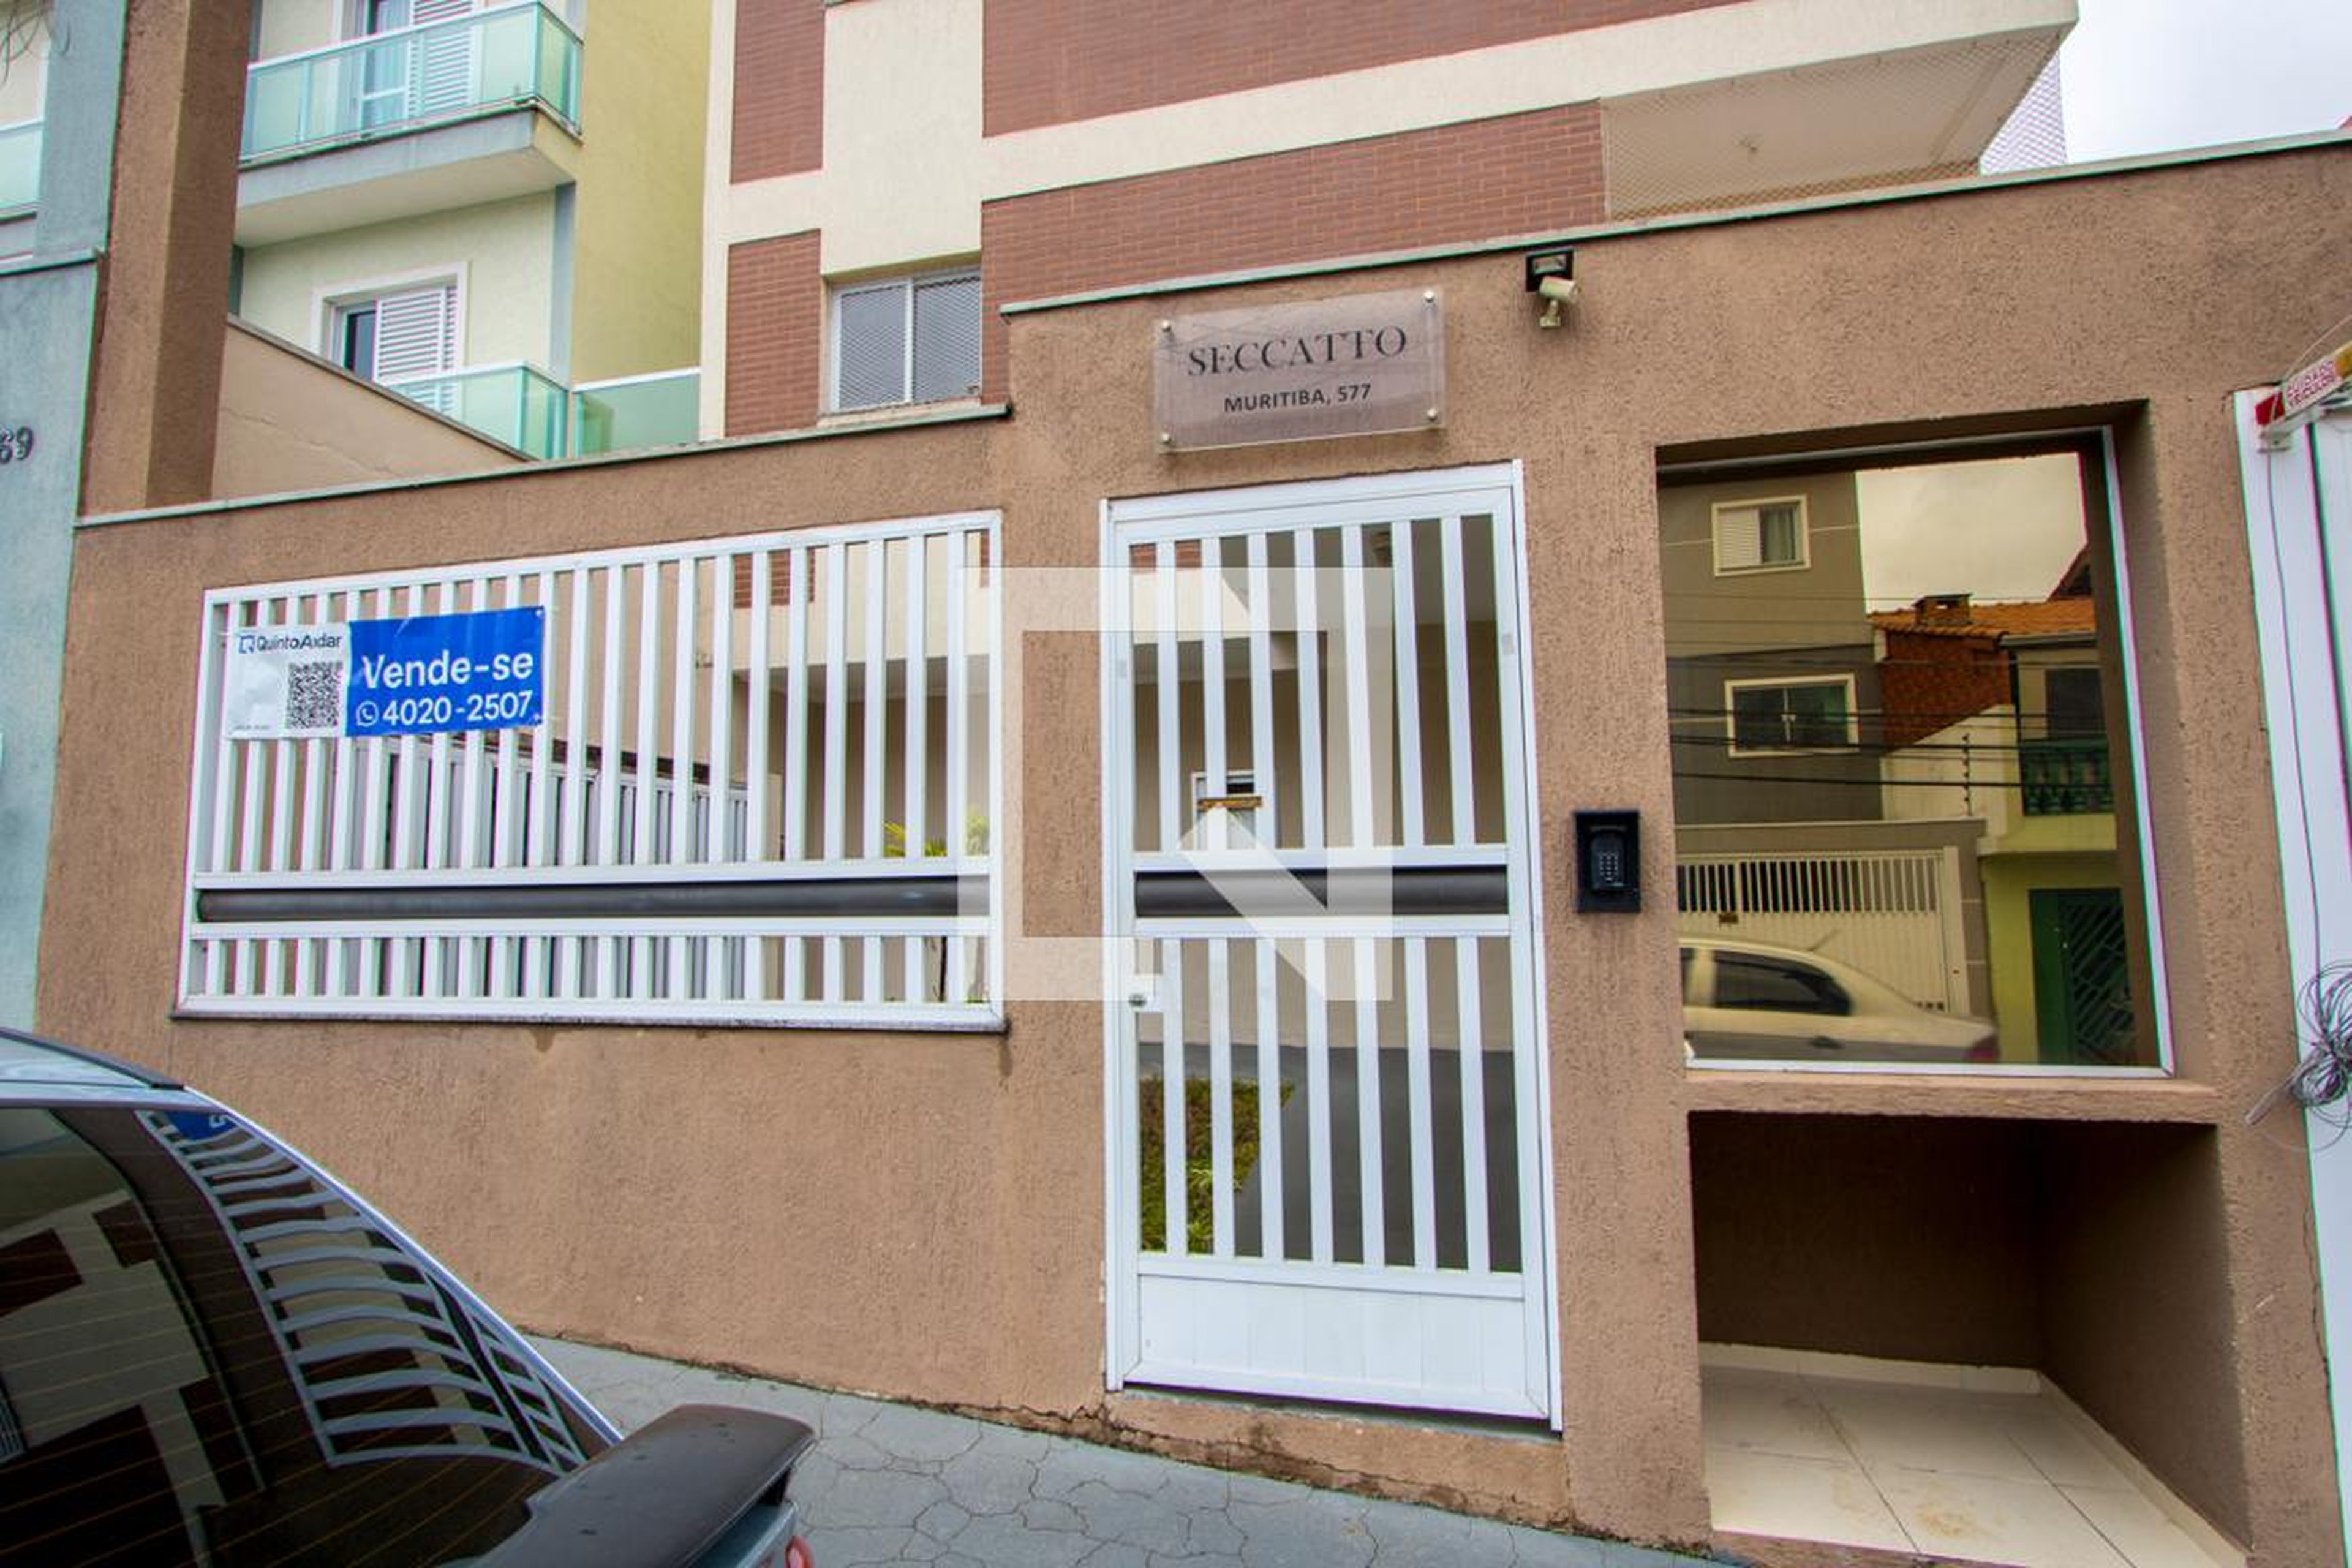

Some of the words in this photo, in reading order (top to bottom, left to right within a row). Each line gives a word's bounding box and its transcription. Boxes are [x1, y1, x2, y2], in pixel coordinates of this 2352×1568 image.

[1187, 326, 1407, 377] SECCATTO
[1224, 389, 1332, 413] MURITIBA,
[1338, 384, 1371, 402] 577
[362, 650, 533, 689] Vende-se
